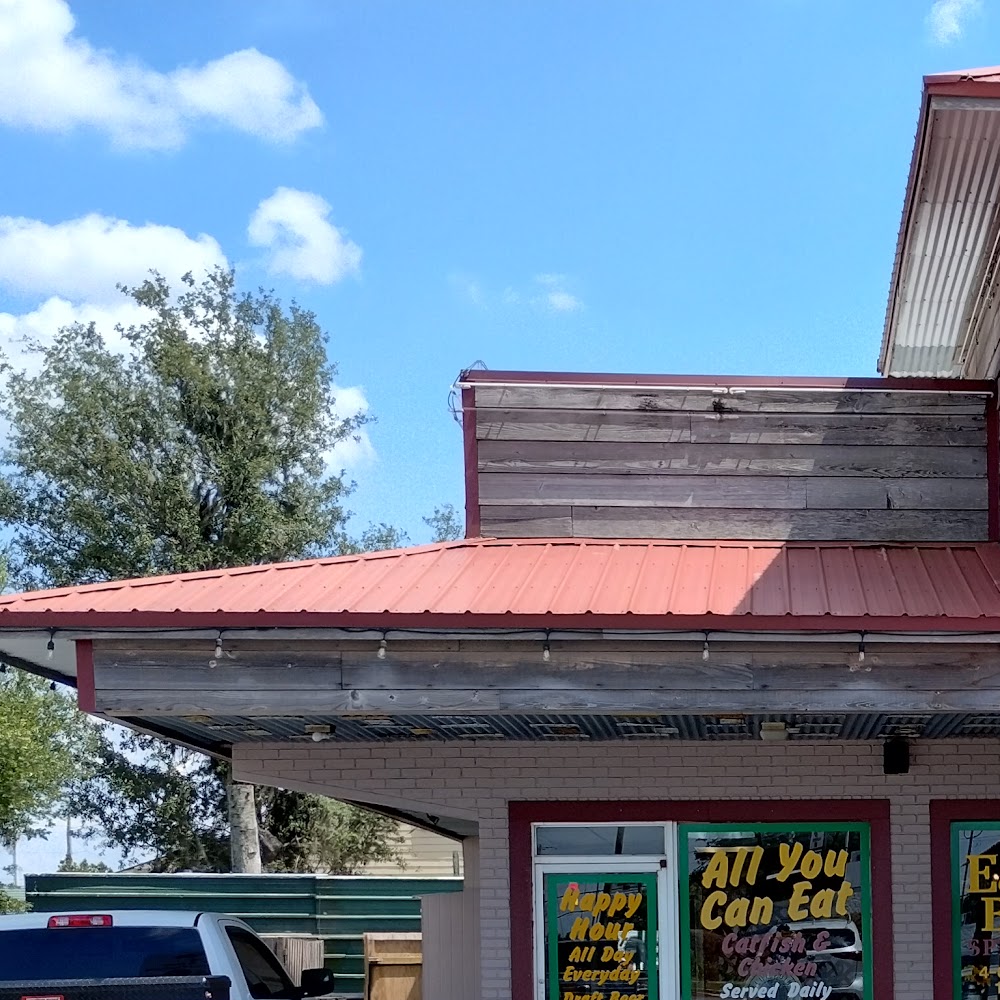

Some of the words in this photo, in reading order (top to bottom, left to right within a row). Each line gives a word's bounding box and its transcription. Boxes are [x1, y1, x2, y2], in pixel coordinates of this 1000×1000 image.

[701, 846, 764, 888] All
[776, 842, 848, 882] You
[560, 883, 642, 918] Happy
[701, 890, 773, 930] Can
[788, 881, 853, 921] Eat
[569, 917, 634, 941] Hour
[568, 946, 596, 962] All
[601, 946, 635, 966] Day
[722, 931, 806, 957] Catfish
[813, 931, 831, 951] &
[563, 966, 640, 985] Everyday
[738, 956, 817, 977] Chicken
[720, 983, 779, 999] Served
